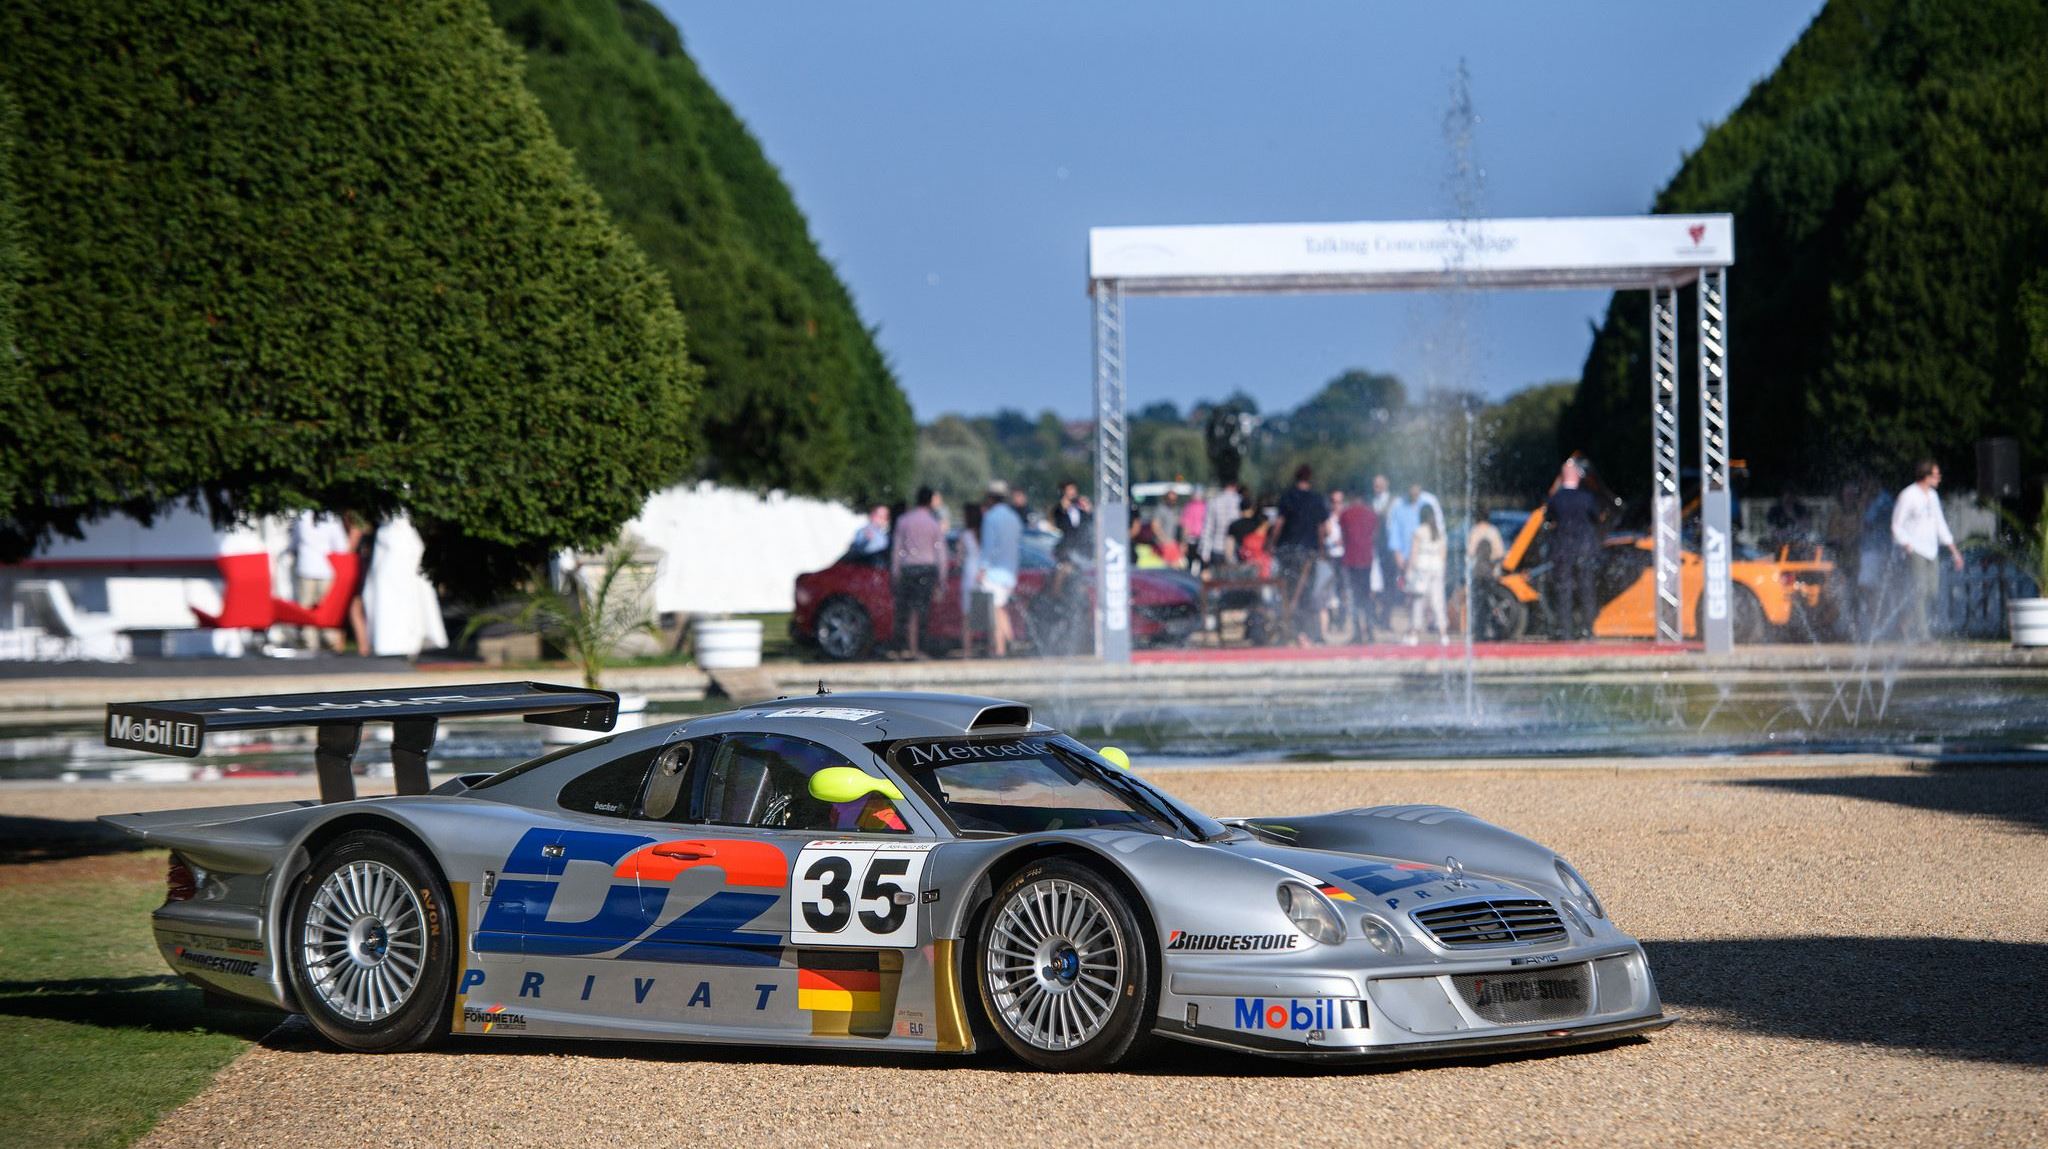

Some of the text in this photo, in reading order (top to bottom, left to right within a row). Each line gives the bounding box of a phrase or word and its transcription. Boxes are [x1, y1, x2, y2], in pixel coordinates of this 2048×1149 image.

[111, 714, 173, 746] Mobil
[472, 827, 788, 967] D2
[802, 856, 910, 934] 35
[421, 887, 441, 936] AVON
[1167, 931, 1299, 950] BRIDGESTONE
[1526, 954, 1559, 965] AMG
[459, 969, 778, 1011] PRIVAT
[464, 1012, 527, 1024] FONDMETAL
[1235, 998, 1333, 1030] Mobil
